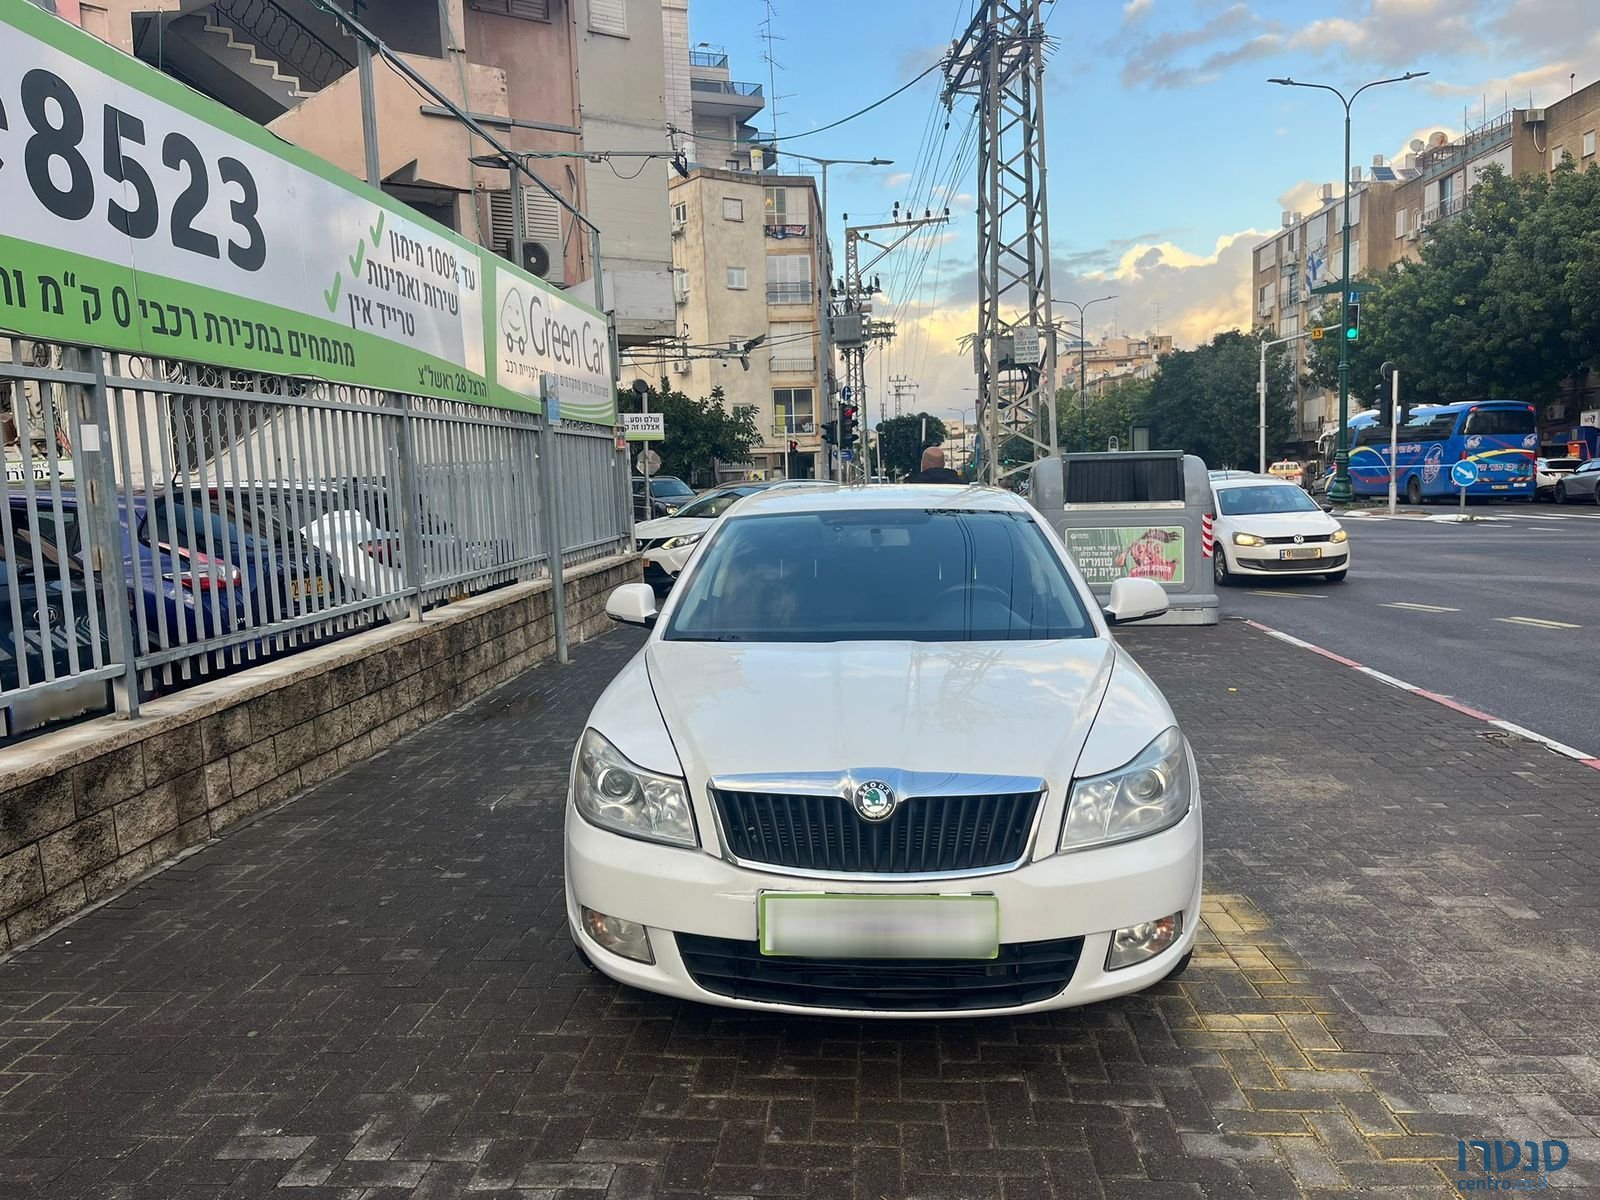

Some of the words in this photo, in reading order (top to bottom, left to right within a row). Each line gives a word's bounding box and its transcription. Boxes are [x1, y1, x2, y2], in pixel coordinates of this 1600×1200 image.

[0, 68, 267, 272] 8523
[388, 229, 425, 268] מימון
[427, 245, 460, 284] 100%
[366, 258, 421, 303] ואמינות
[461, 265, 476, 292] עד
[347, 293, 374, 330] אין
[423, 282, 459, 317] שירות
[138, 298, 199, 341] רכבי
[203, 311, 284, 357] במכירת
[376, 302, 416, 337] טרייד
[529, 295, 581, 367] Green
[582, 321, 605, 376] Car
[287, 329, 356, 368] מתמחים
[455, 372, 467, 394] 28
[467, 375, 488, 398] הרצל
[643, 415, 660, 423] שלם
[1079, 557, 1113, 567] שומרים
[1100, 567, 1121, 577] עליה
